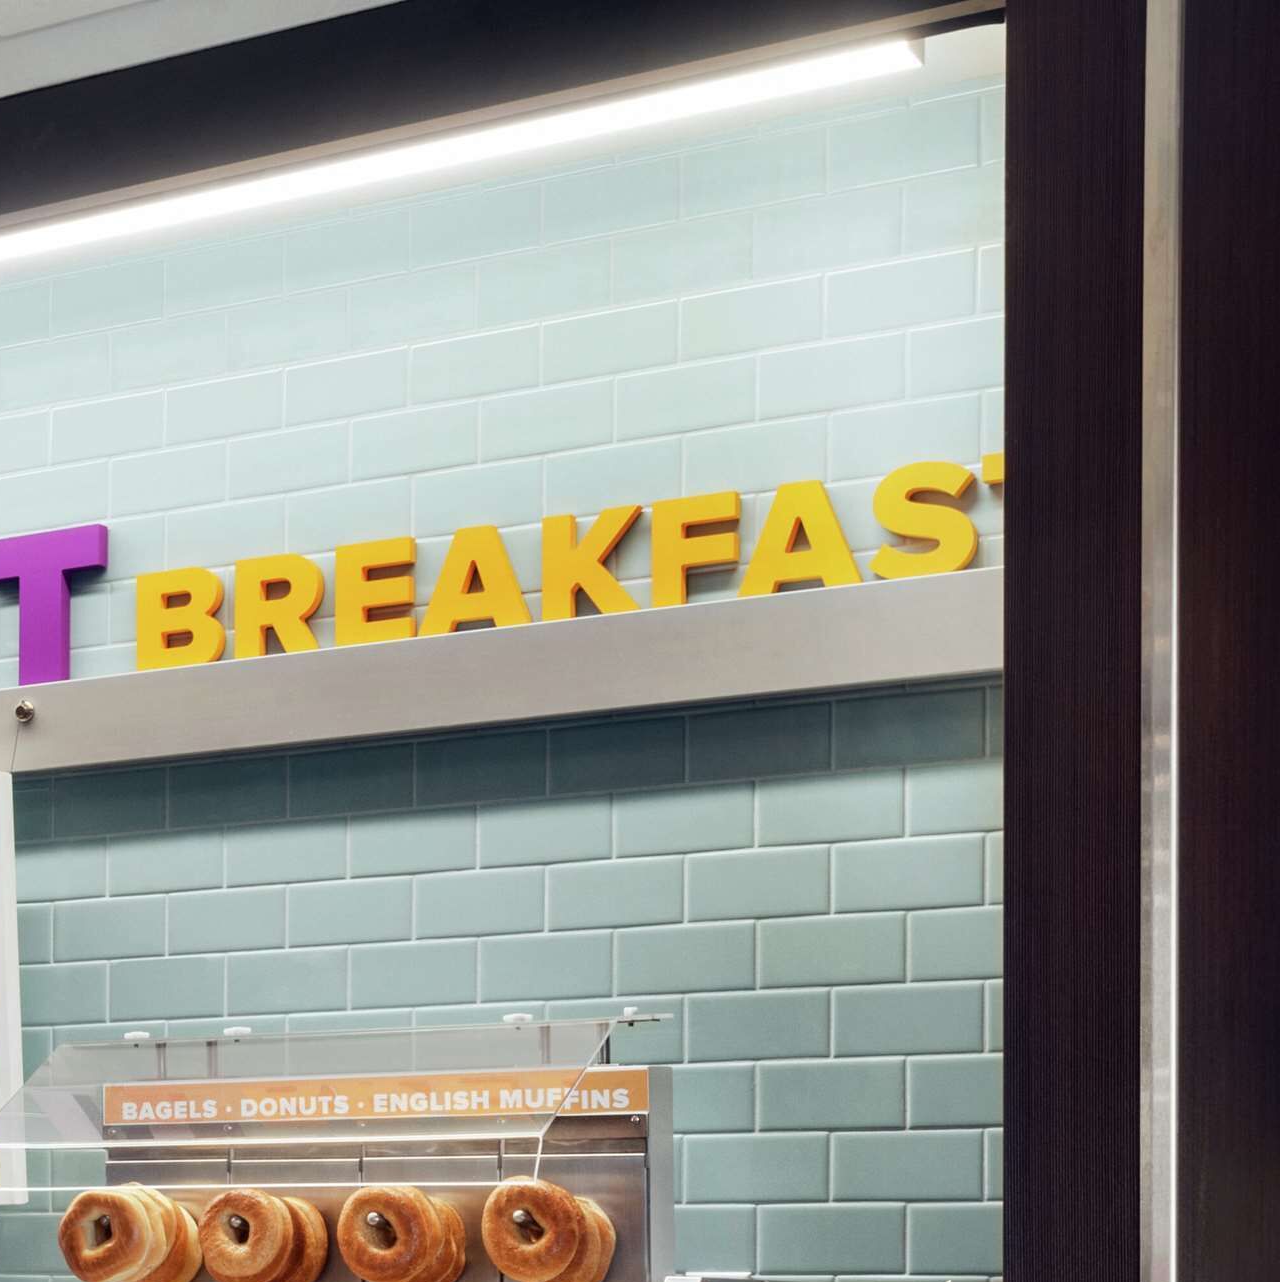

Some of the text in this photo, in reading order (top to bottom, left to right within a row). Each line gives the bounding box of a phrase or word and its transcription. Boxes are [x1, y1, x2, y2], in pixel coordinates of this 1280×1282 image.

[136, 453, 1005, 672] BREAKFAS
[121, 1087, 630, 1121] BAGELS DONUTS ENGLISH MUFFINS
